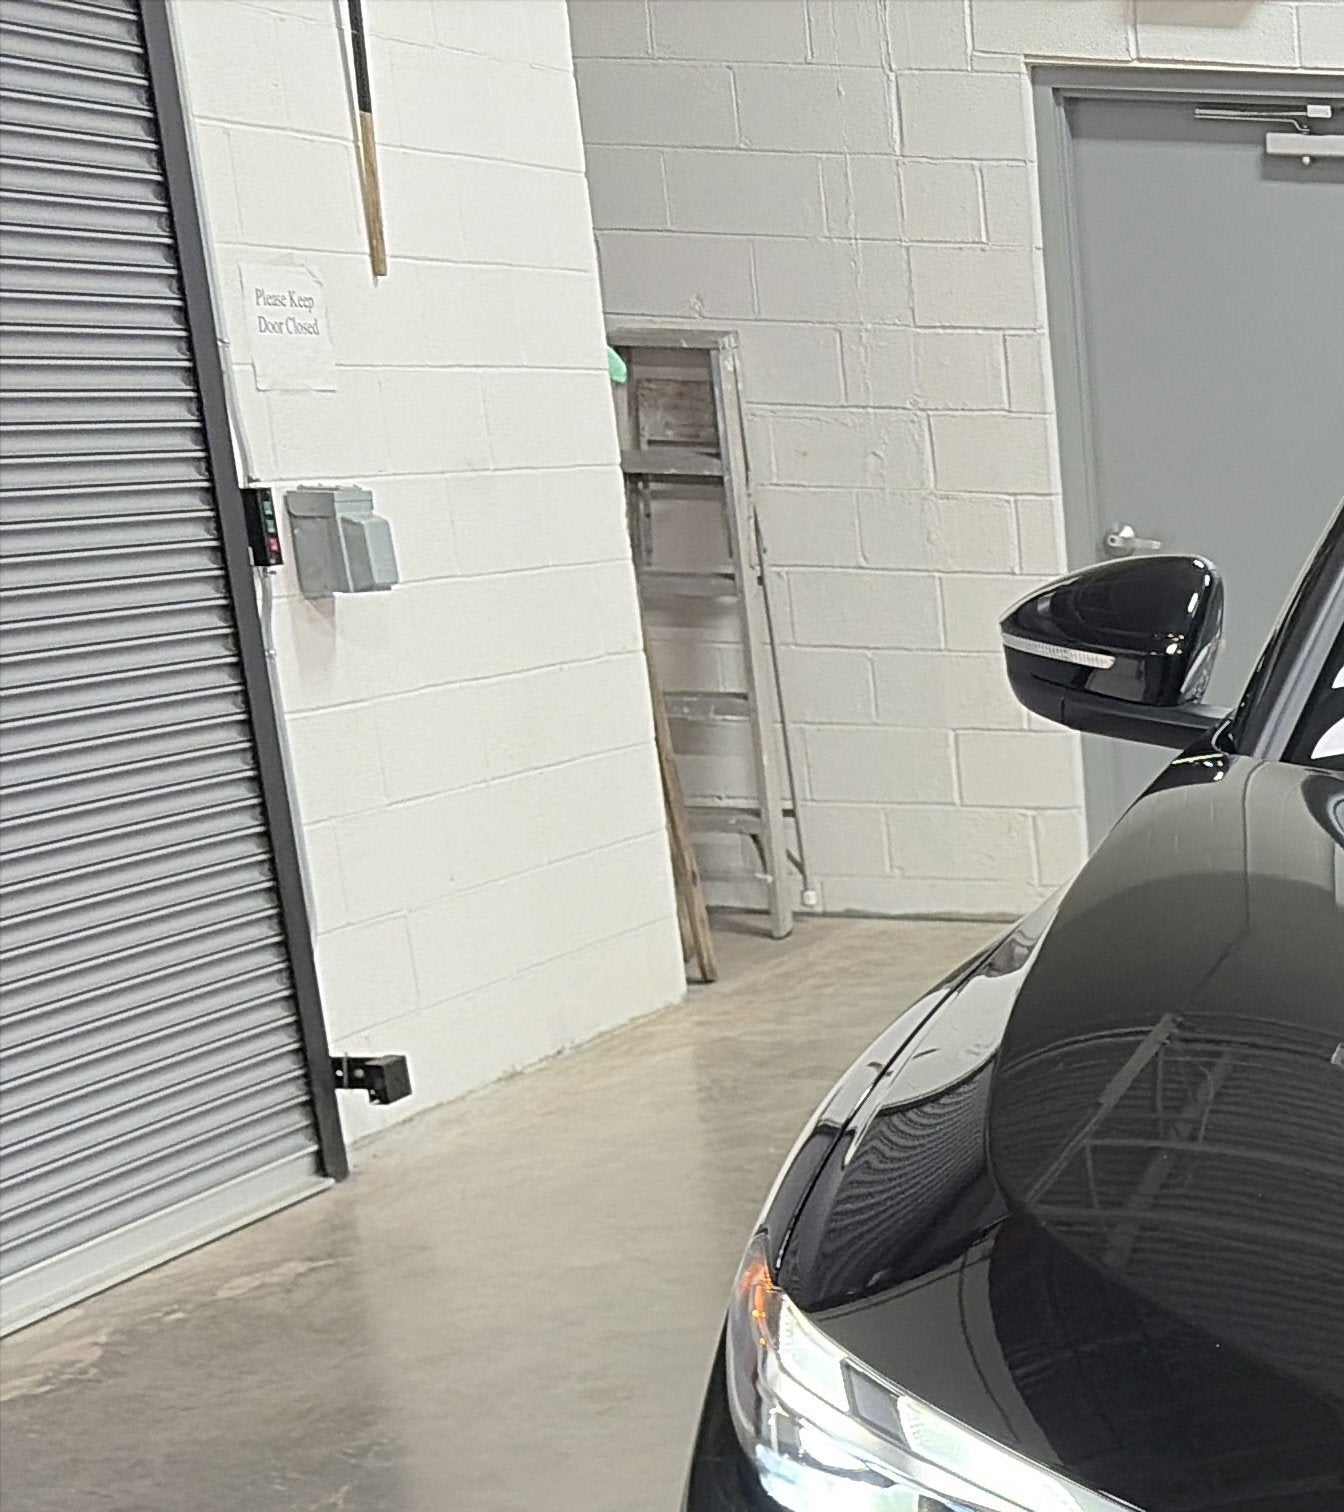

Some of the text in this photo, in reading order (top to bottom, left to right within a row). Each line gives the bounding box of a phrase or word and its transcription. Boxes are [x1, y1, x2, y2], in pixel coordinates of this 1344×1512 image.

[255, 288, 315, 313] Please Keep
[257, 316, 320, 336] Door Closed
